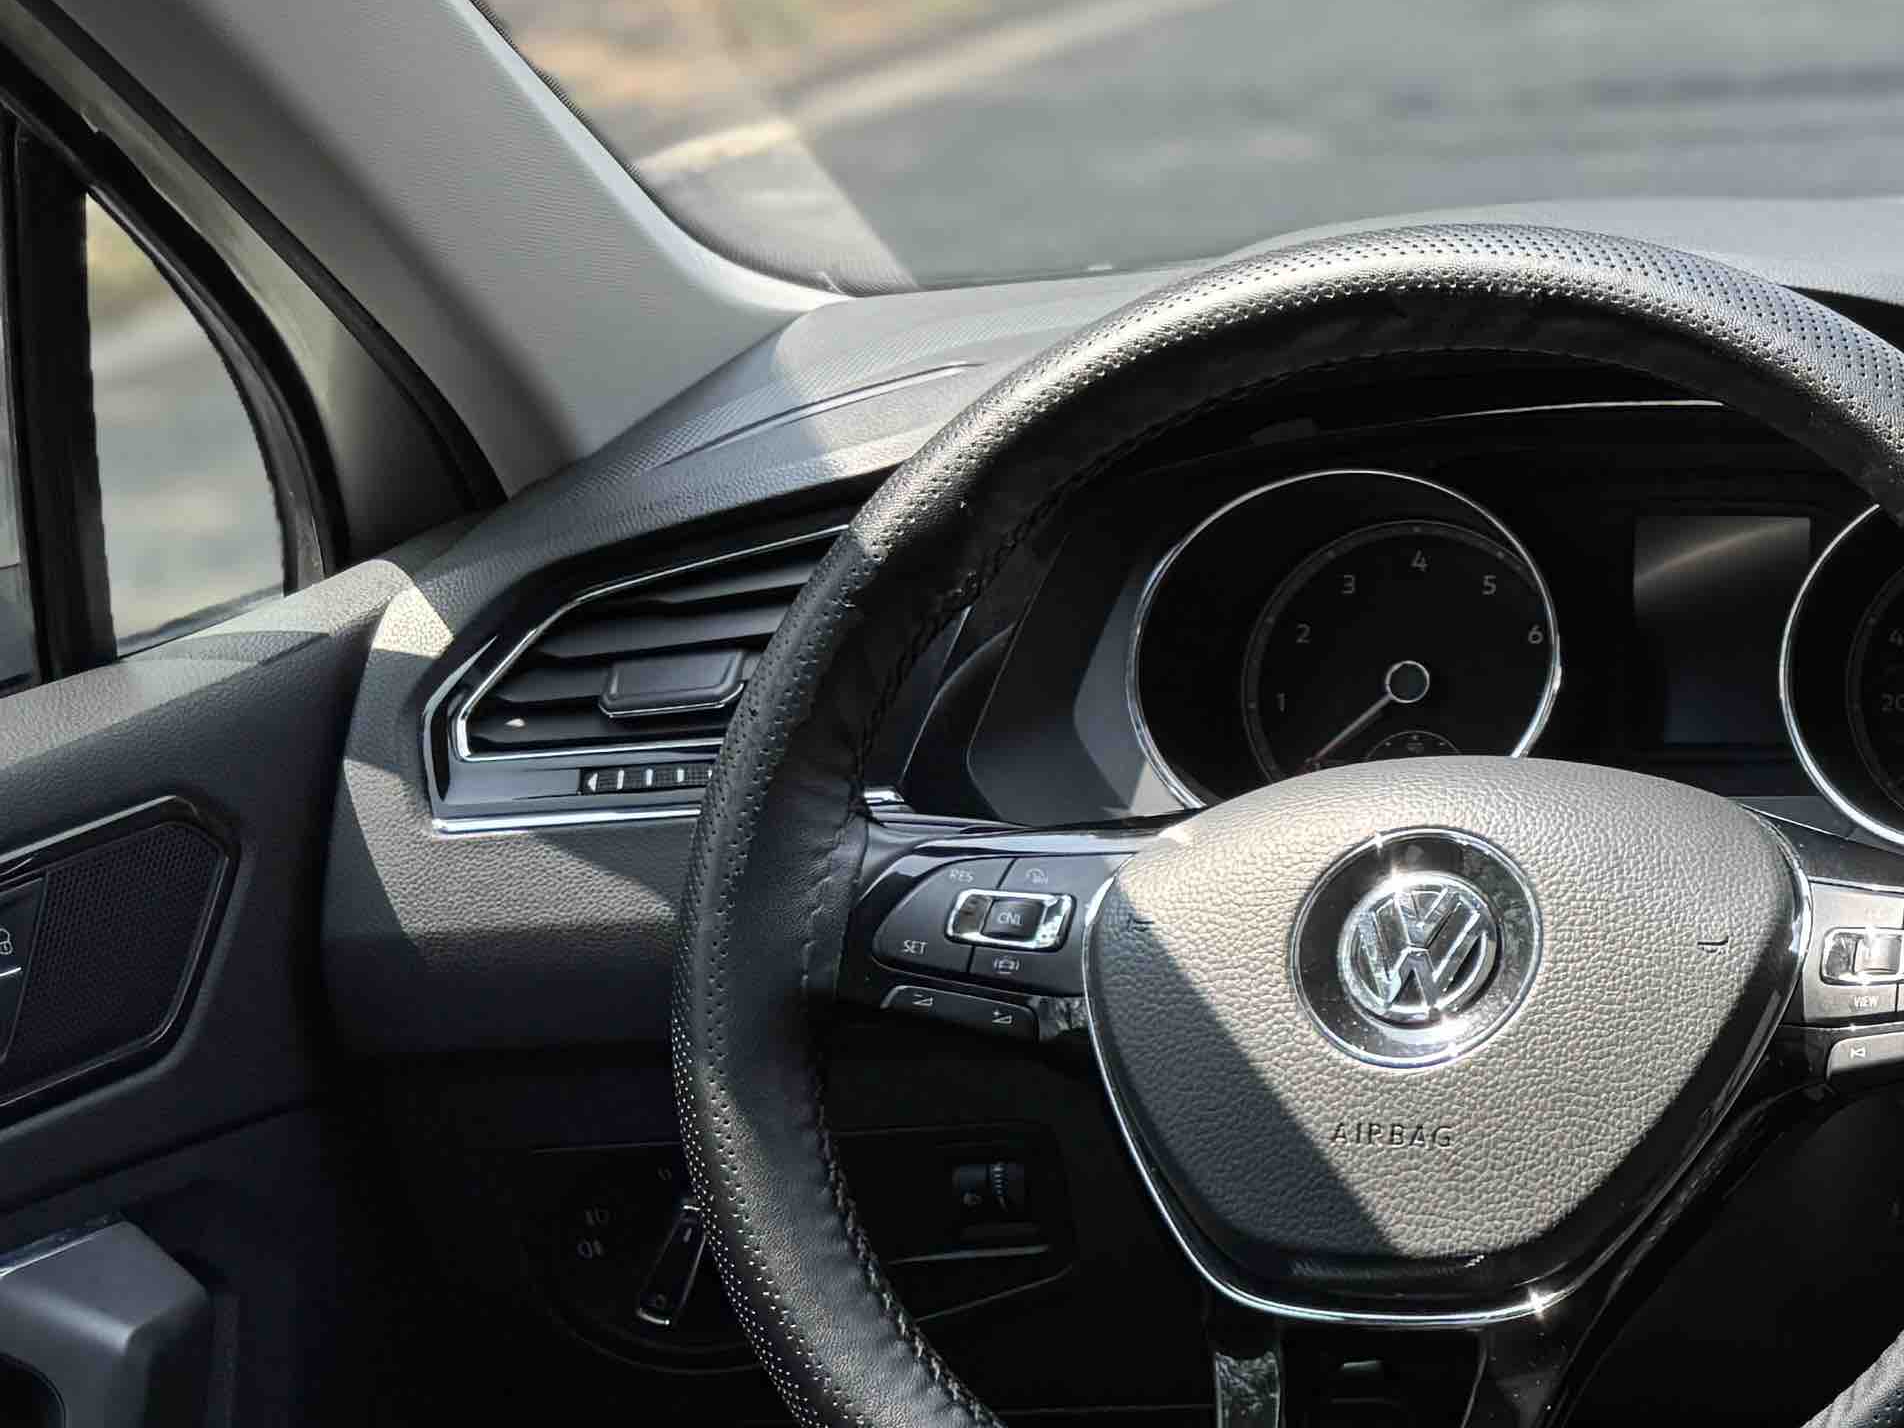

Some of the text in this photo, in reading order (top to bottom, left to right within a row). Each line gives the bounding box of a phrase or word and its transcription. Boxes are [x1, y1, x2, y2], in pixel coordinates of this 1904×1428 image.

[1412, 550, 1427, 571] 4
[1343, 575, 1355, 594] 3
[1482, 575, 1497, 595] 5
[1296, 624, 1311, 643] 2
[1528, 625, 1543, 644] 6
[1277, 694, 1285, 711] 1
[951, 871, 974, 883] RES
[904, 939, 927, 954] SET
[1854, 996, 1878, 1009] VIEW
[1331, 1122, 1452, 1148] AIRBAG
